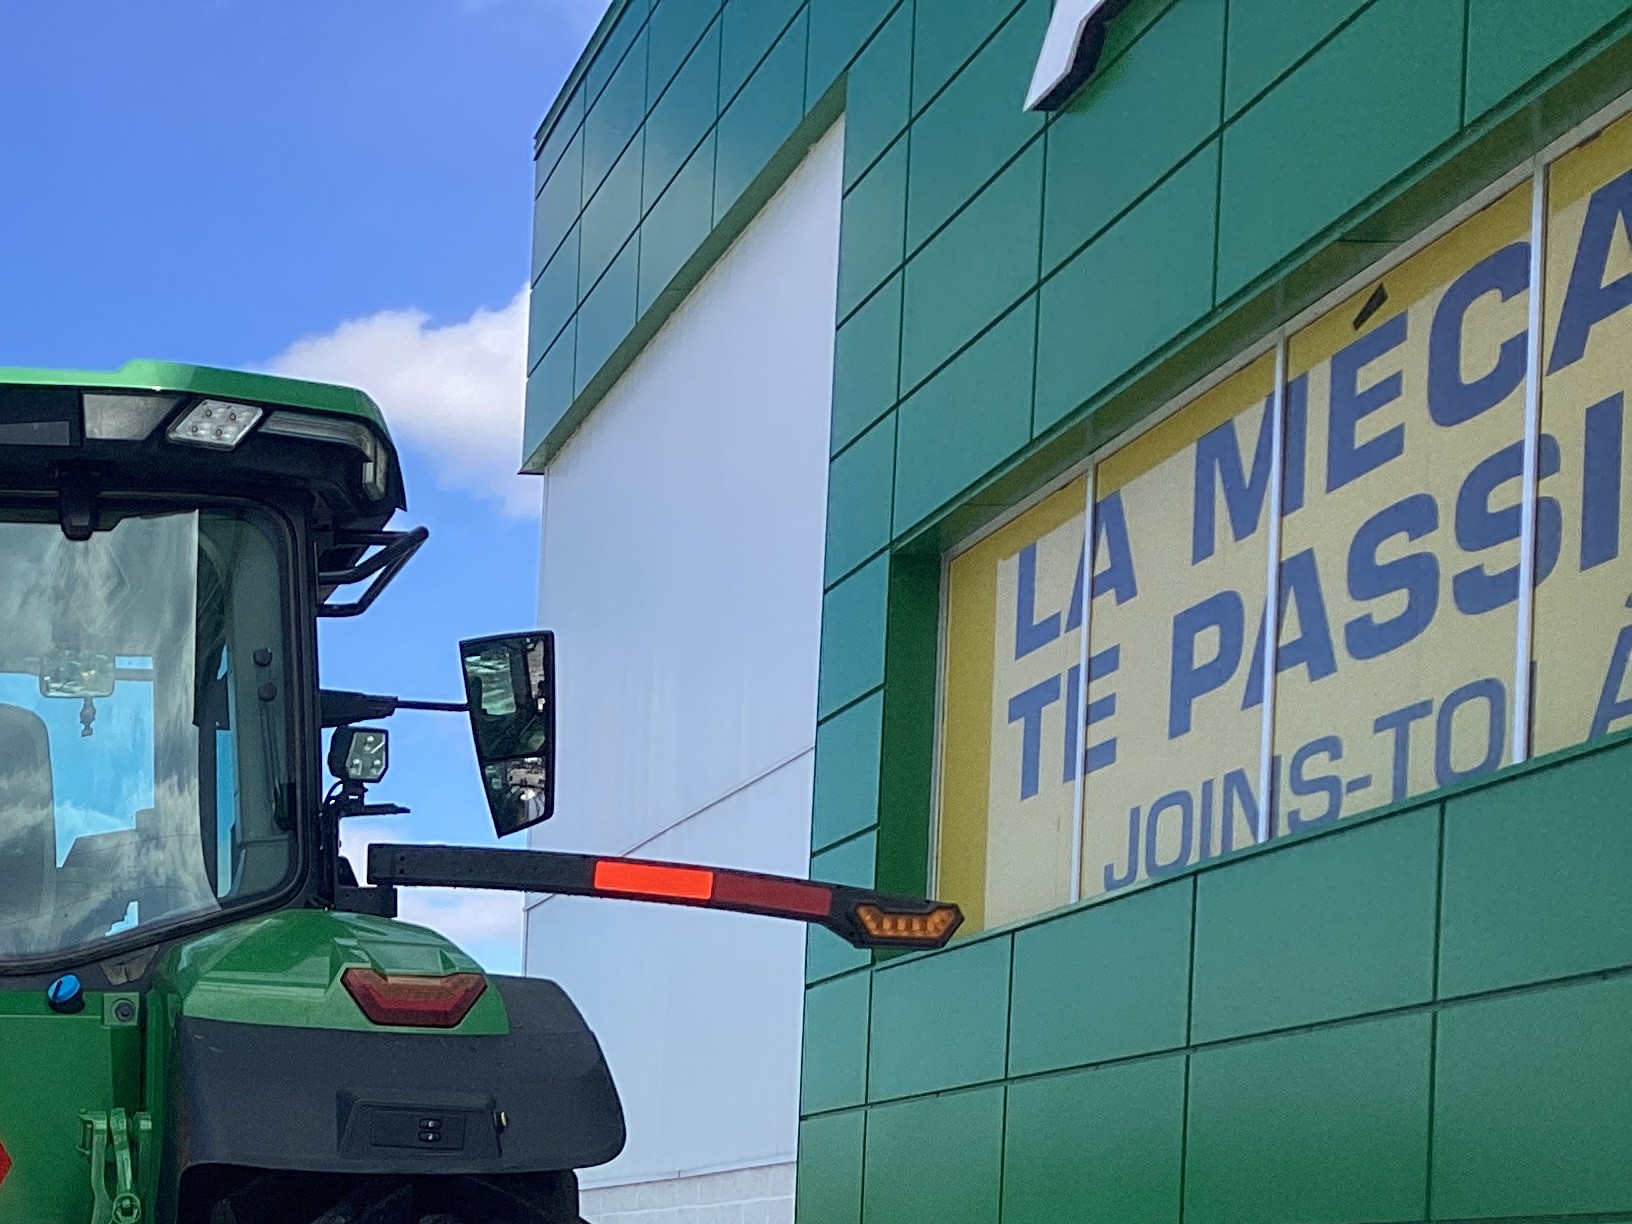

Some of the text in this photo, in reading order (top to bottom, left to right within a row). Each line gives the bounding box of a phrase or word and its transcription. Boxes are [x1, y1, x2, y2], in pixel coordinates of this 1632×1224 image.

[1007, 643, 1120, 801] TE
[1168, 390, 1624, 740] PASSI
[1014, 490, 1137, 661] LA
